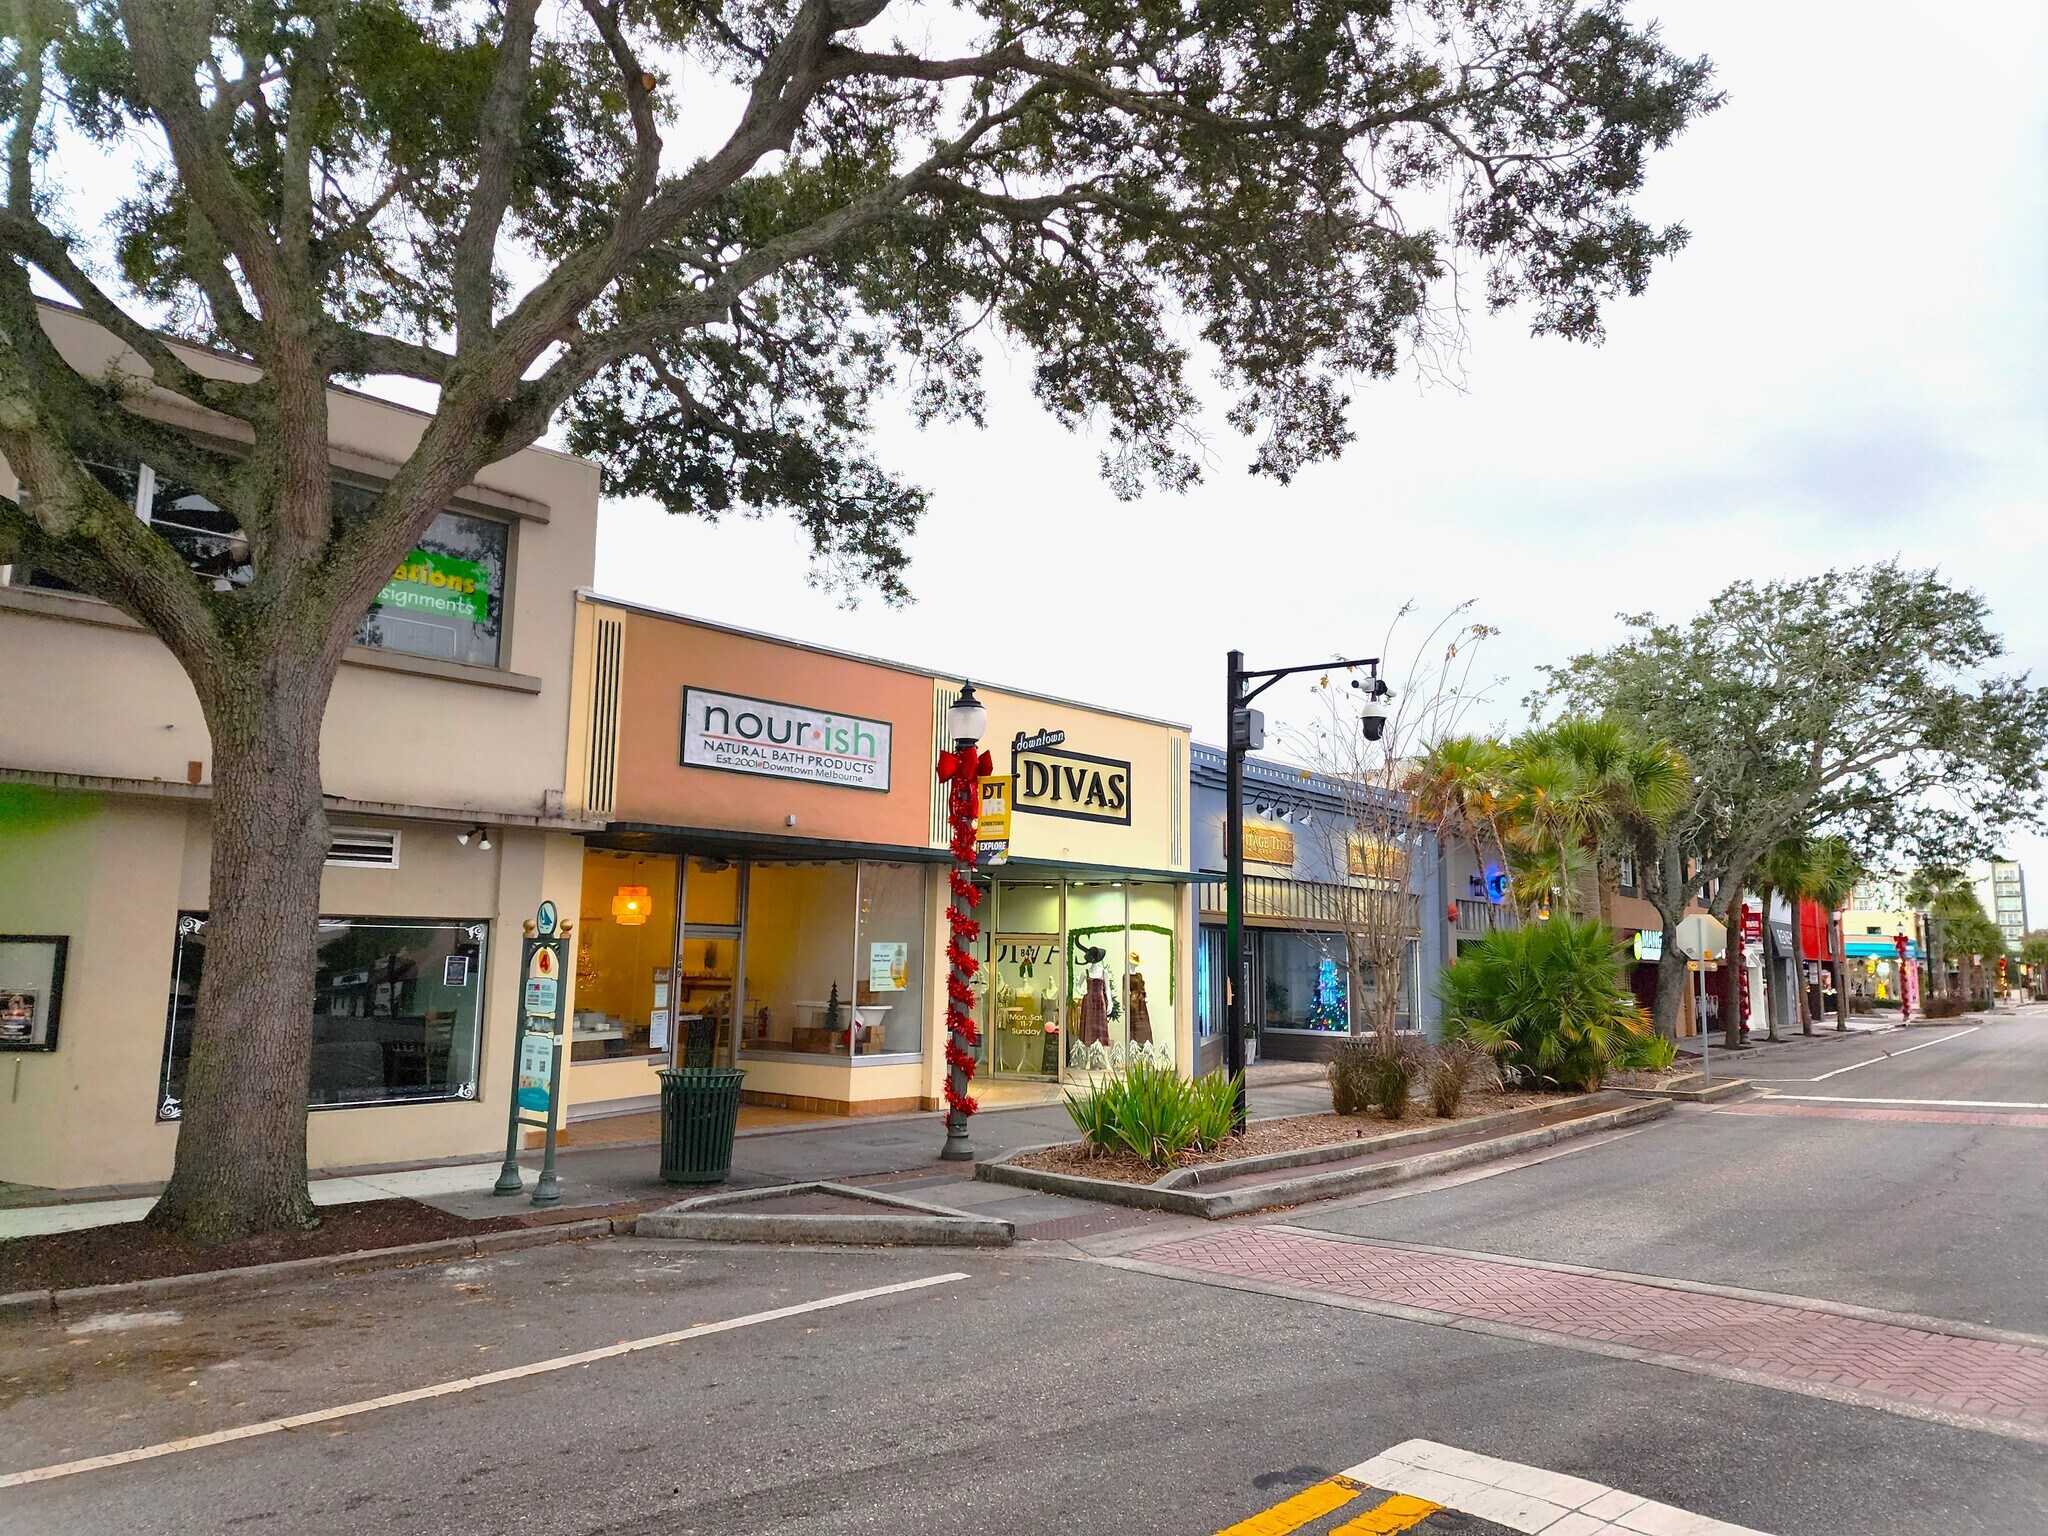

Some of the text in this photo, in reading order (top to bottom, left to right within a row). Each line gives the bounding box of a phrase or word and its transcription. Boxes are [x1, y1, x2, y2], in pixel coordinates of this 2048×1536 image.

[1016, 731, 1064, 751] downtown
[703, 739, 874, 775] NATURAL BATH PRODUCTS
[815, 768, 863, 783] Melbourne
[982, 782, 1005, 799] DT
[1023, 760, 1125, 810] DIVAS
[980, 841, 1007, 851] EXPLORE
[1020, 948, 1035, 958] 847
[539, 954, 549, 971] 4
[1011, 1027, 1041, 1036] Sunday
